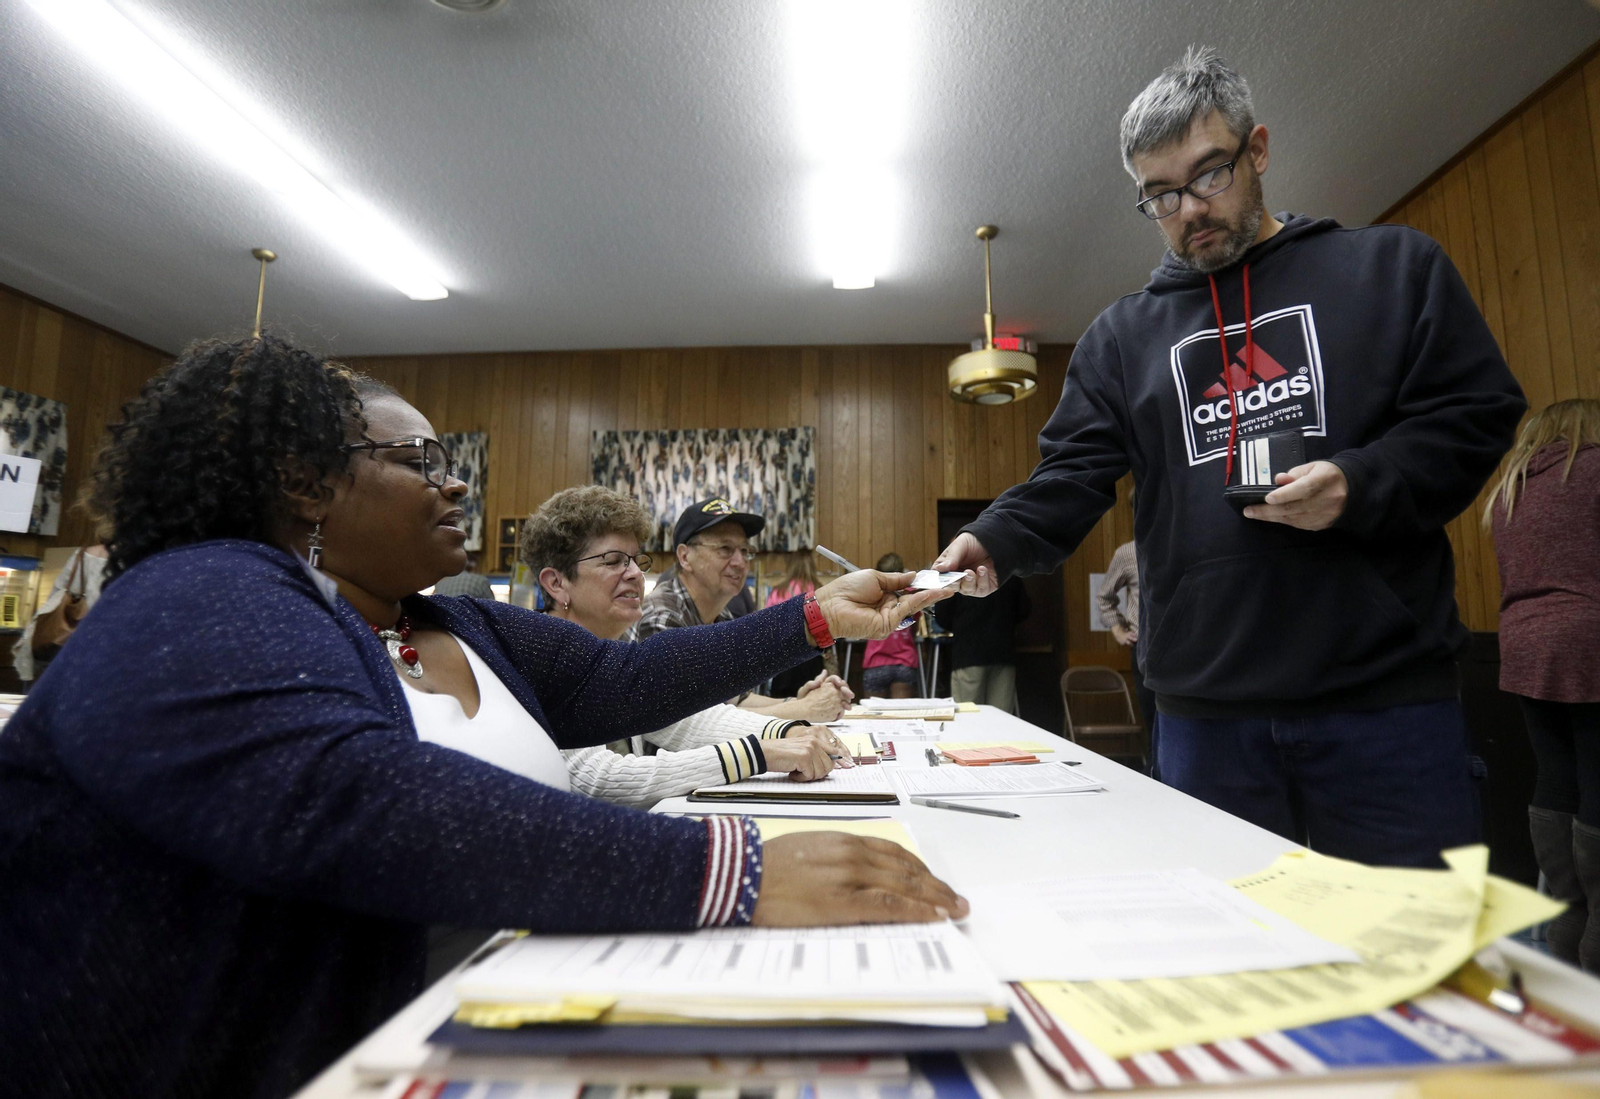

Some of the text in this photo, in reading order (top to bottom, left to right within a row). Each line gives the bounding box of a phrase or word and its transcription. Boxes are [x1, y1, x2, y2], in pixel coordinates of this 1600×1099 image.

[1193, 375, 1312, 425] adidas
[1206, 411, 1304, 443] ESTALISHED 1949
[1219, 424, 1241, 433] BRAD
[1241, 418, 1256, 428] WITH
[1256, 414, 1269, 422] THE
[1273, 404, 1302, 417] STRIPES
